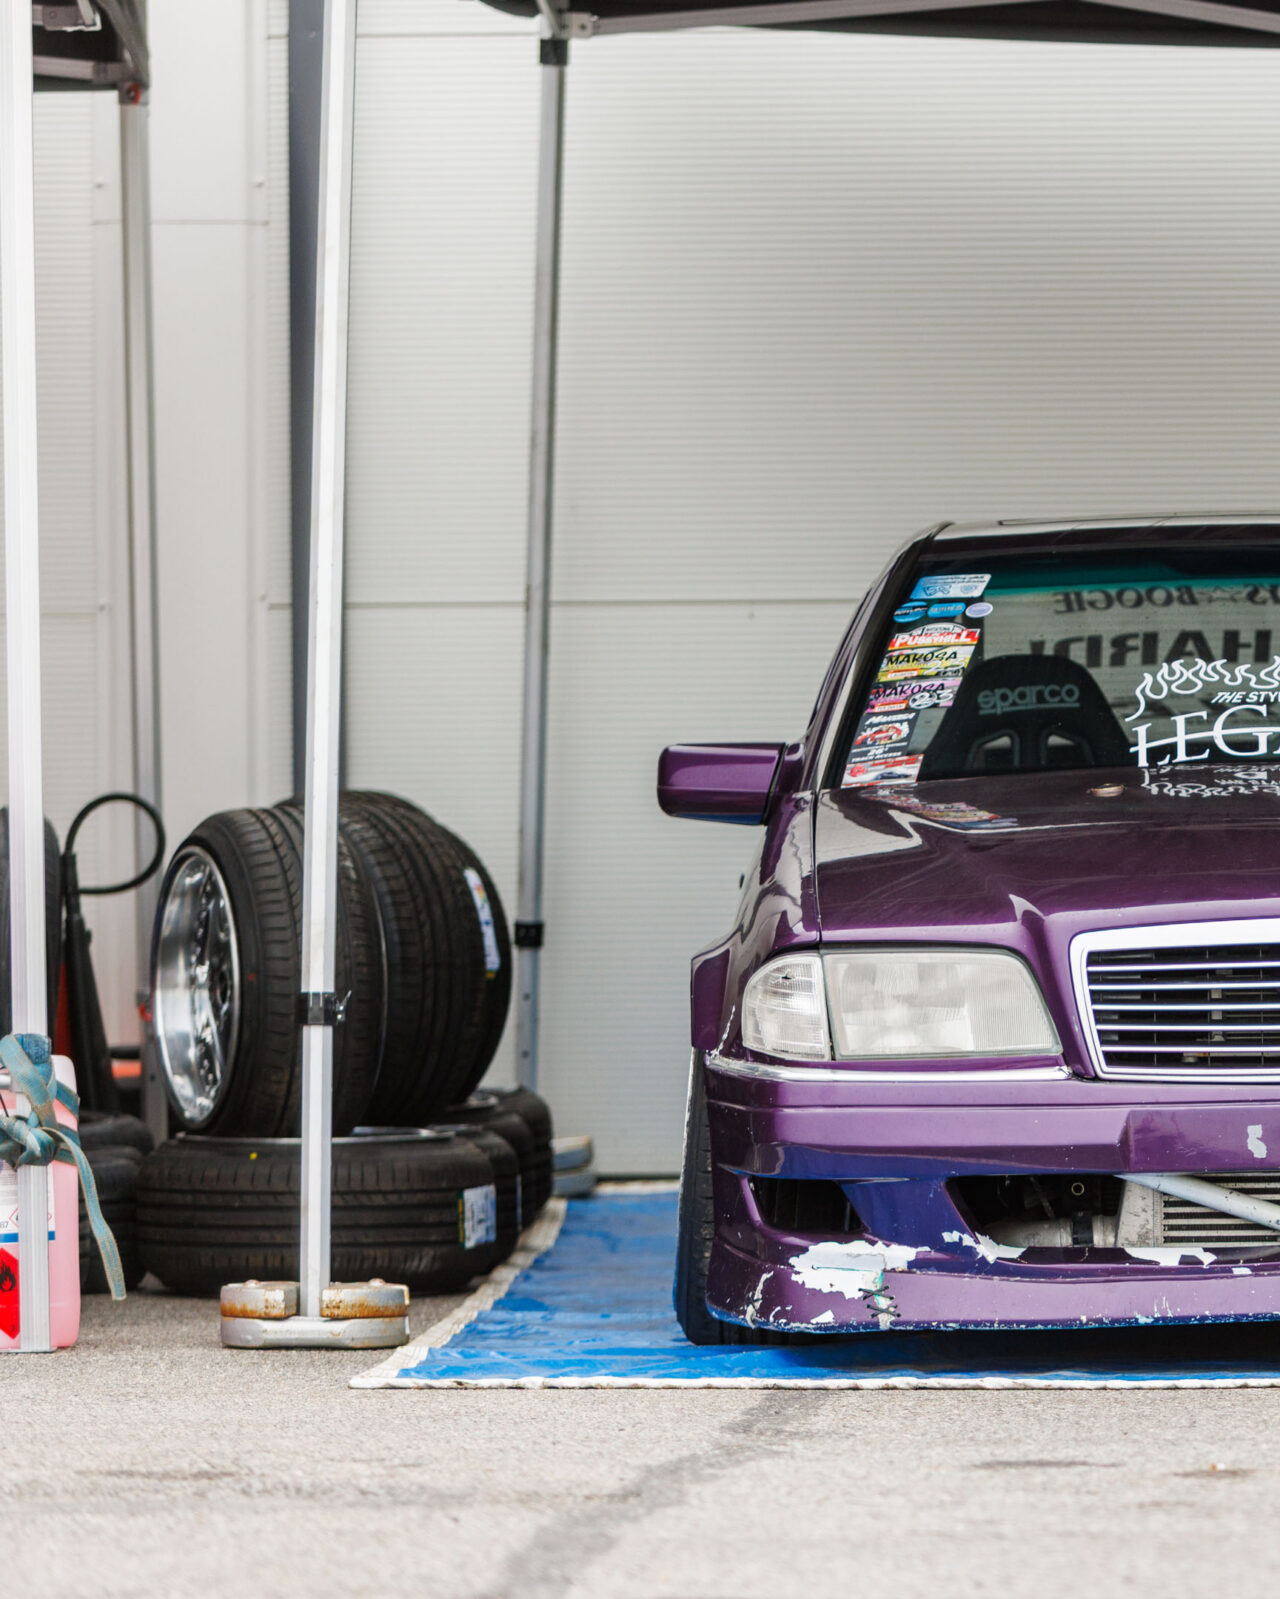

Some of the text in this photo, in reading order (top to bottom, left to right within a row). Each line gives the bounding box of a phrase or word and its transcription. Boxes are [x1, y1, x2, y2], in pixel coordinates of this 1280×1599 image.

[886, 650, 958, 666] MAKOSA
[977, 684, 1080, 715] sparco
[1211, 691, 1246, 704] THE
